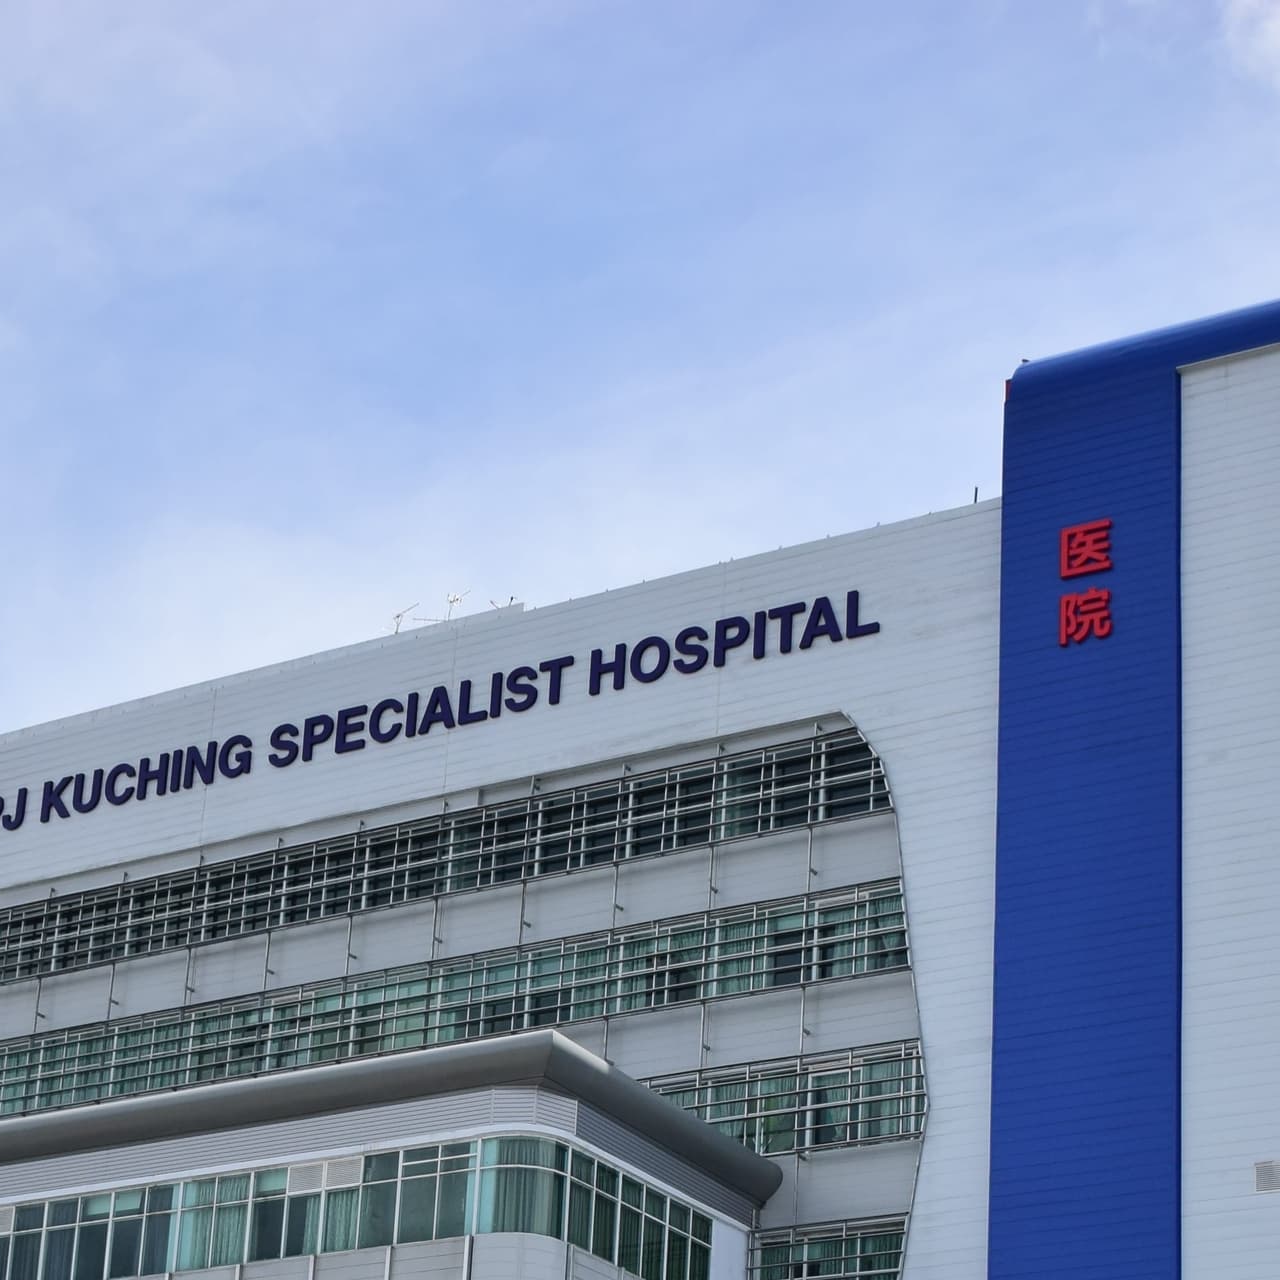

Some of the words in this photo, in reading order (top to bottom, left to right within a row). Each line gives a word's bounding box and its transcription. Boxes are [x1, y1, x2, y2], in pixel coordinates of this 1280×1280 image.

[1059, 518, 1113, 647] 医院
[40, 734, 253, 824] KUCHING
[268, 655, 575, 768] SPECIALIST
[588, 590, 881, 697] HOSPITAL
